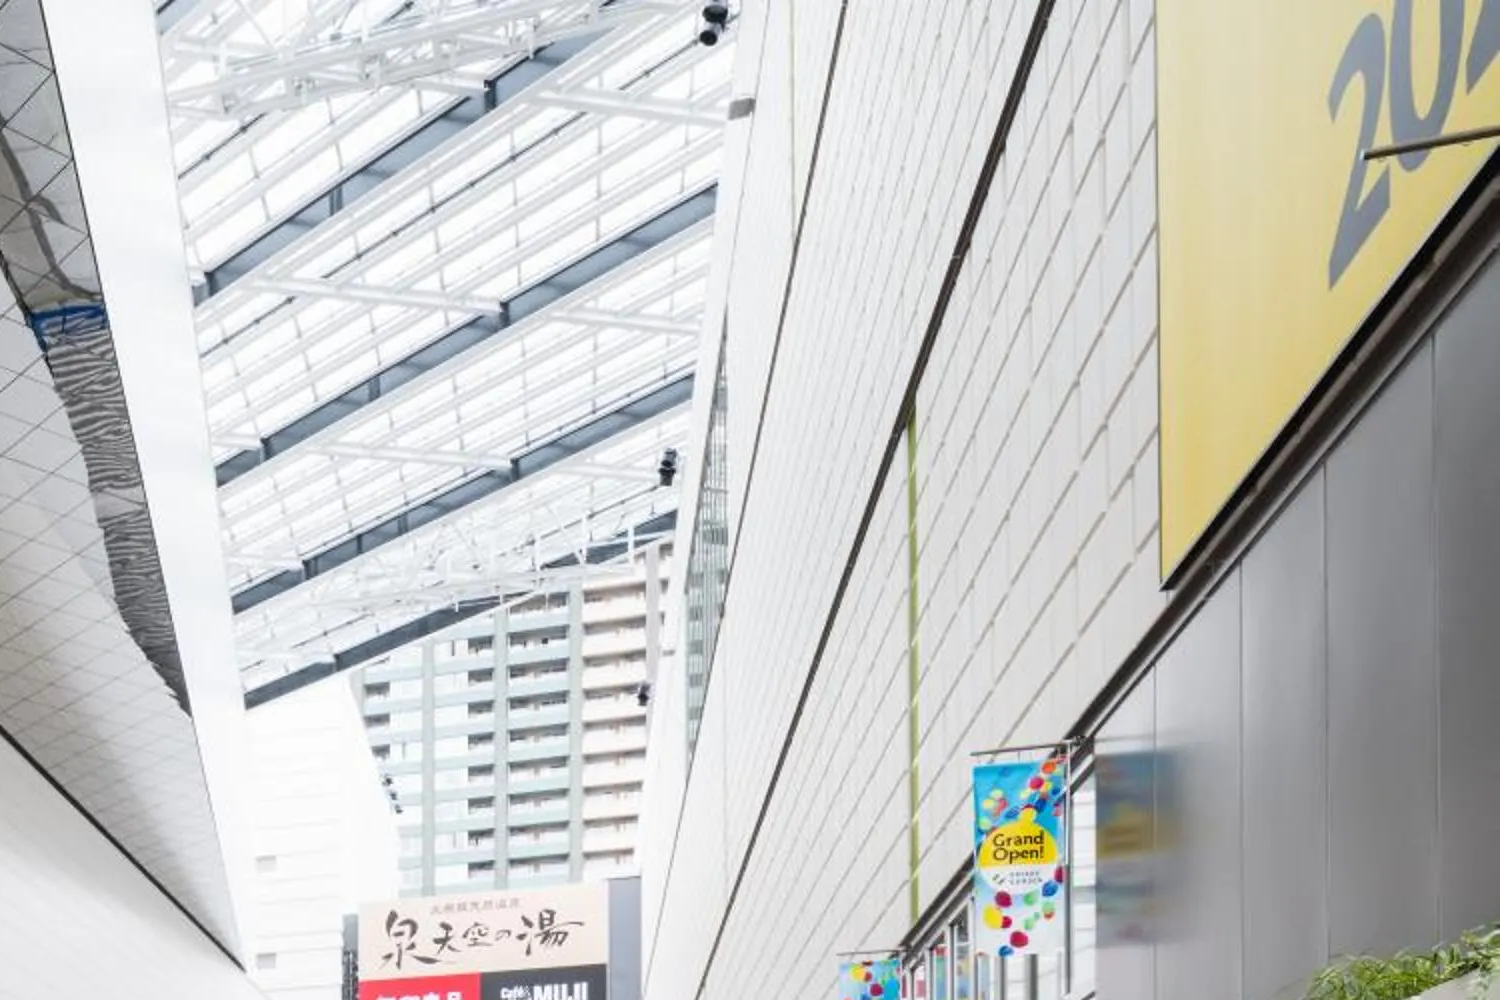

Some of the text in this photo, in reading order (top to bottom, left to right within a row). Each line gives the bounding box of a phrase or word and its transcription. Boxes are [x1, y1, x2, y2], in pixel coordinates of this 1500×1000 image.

[993, 829, 1045, 847] Grand
[993, 845, 1045, 865] Open!
[380, 908, 586, 971] 泉天空の湯
